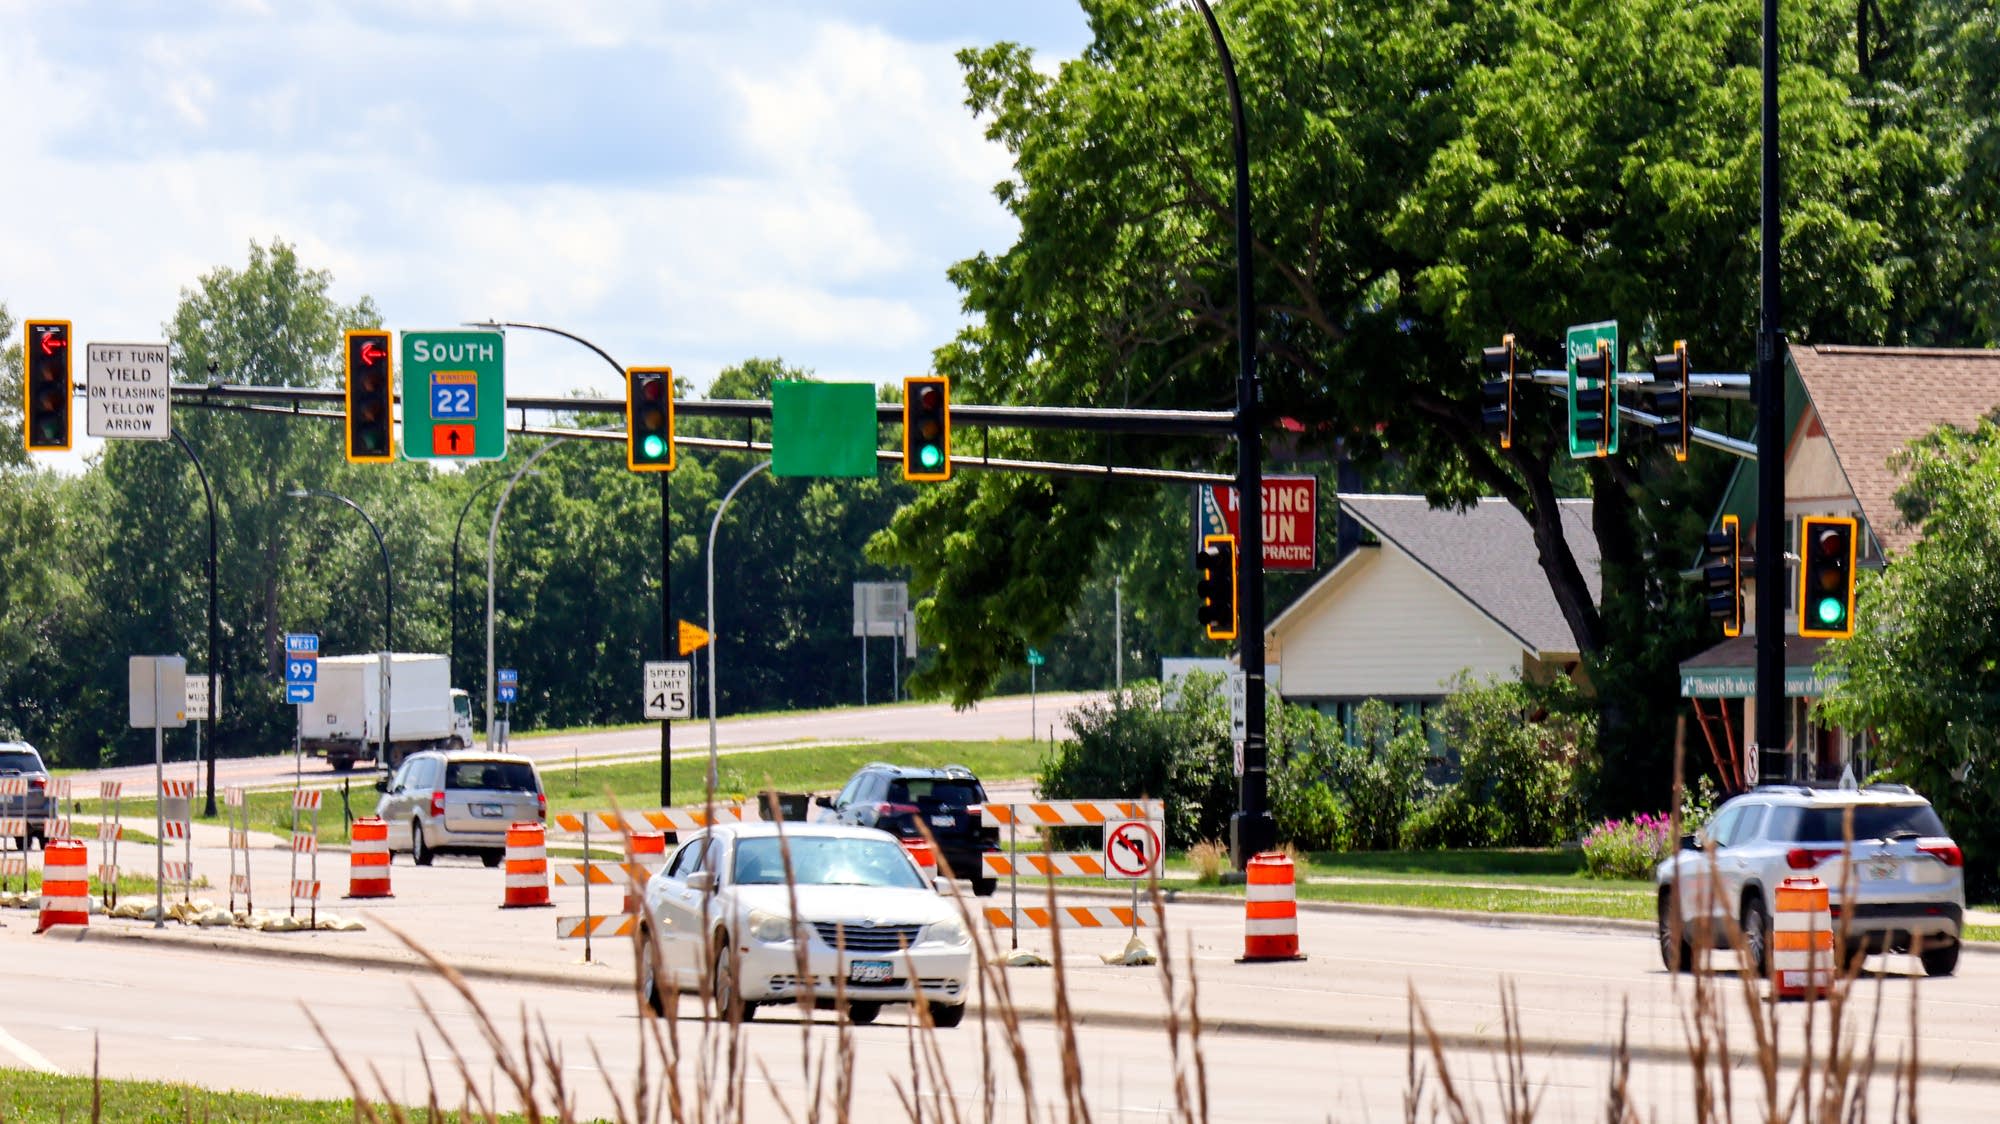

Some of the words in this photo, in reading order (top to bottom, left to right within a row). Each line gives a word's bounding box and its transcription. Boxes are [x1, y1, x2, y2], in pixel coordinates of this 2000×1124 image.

[92, 351, 122, 362] LEFT
[130, 351, 164, 363] TURN
[413, 339, 494, 362] SOUTH
[106, 367, 151, 382] YIELD
[91, 385, 106, 398] ON
[112, 387, 165, 399] FLASHING
[437, 389, 470, 413] 22
[103, 402, 154, 415] YELLOW
[105, 418, 152, 431] ARROW
[1228, 486, 1310, 512] RSING
[1262, 514, 1295, 543] UN
[1236, 545, 1311, 560] PRACTIC
[290, 637, 314, 650] WEST
[290, 662, 313, 679] 99
[649, 669, 686, 678] SPEED
[653, 680, 681, 689] LIMIT
[1233, 679, 1243, 693] ONE
[501, 687, 514, 699] 99
[649, 692, 685, 711] 45
